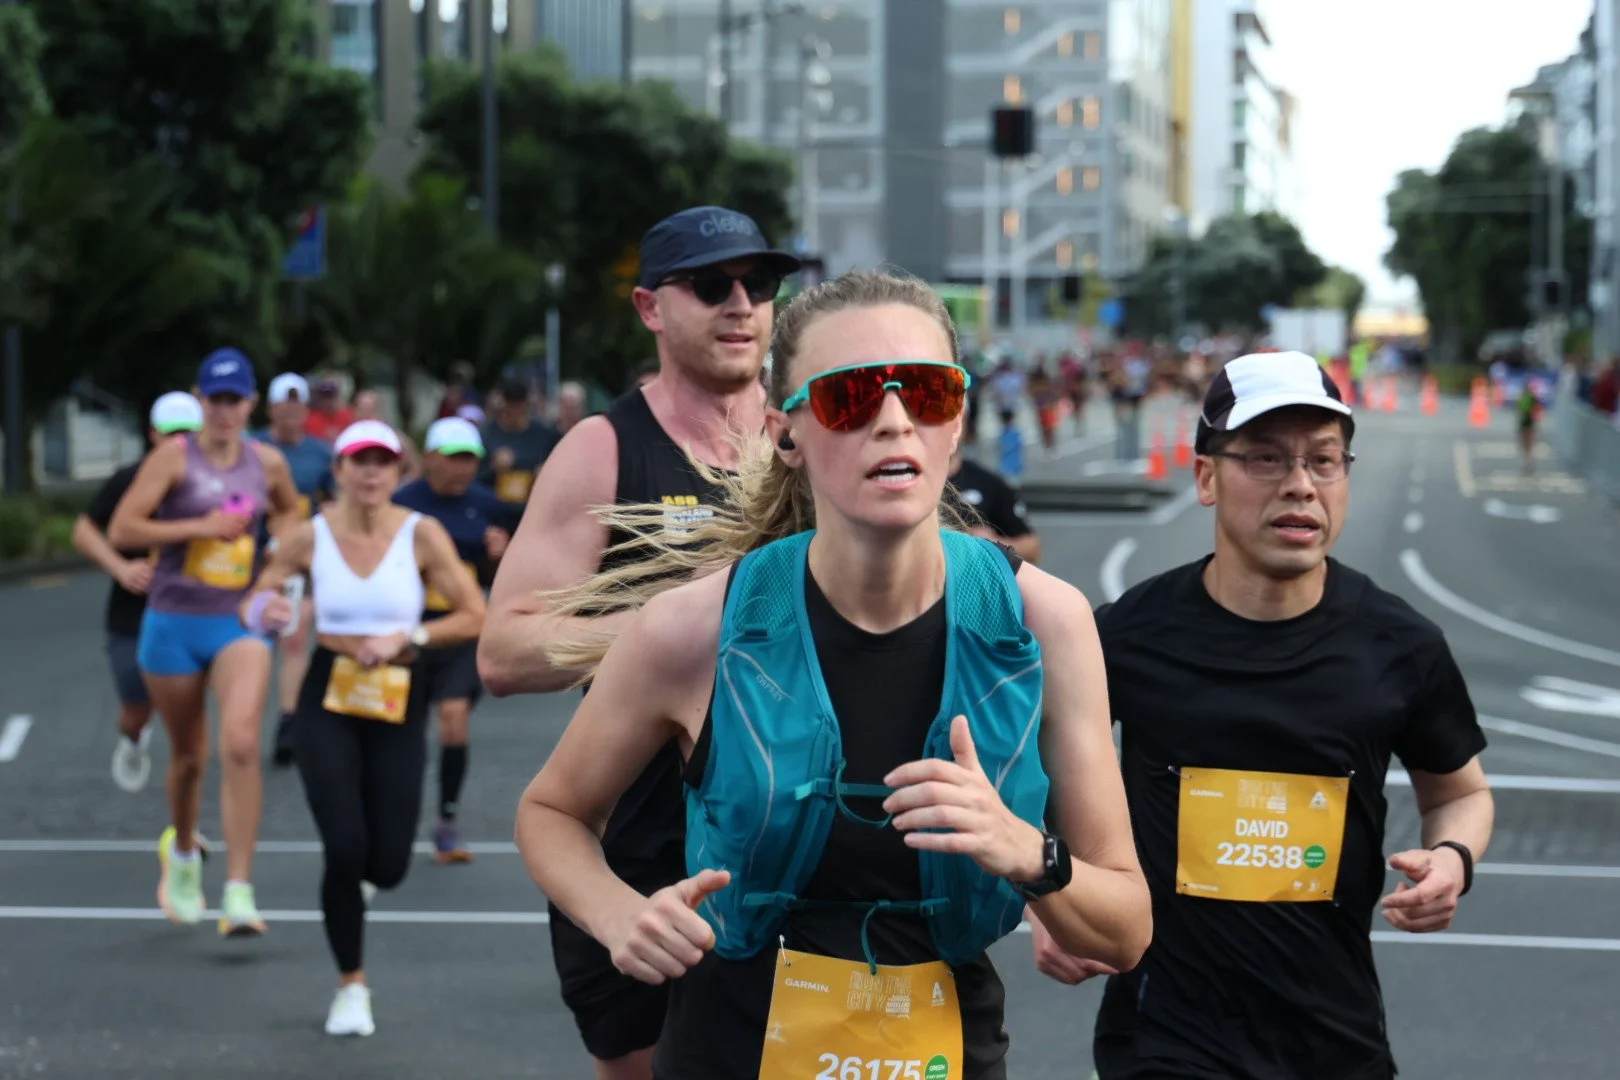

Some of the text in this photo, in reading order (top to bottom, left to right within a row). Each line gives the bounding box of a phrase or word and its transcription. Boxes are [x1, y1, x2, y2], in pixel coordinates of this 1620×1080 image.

[1235, 818, 1289, 838] DAVID
[1216, 842, 1303, 869] 22538
[785, 978, 829, 992] GARMIN
[815, 1052, 921, 1080] 26175
[929, 1063, 946, 1072] GREEN
